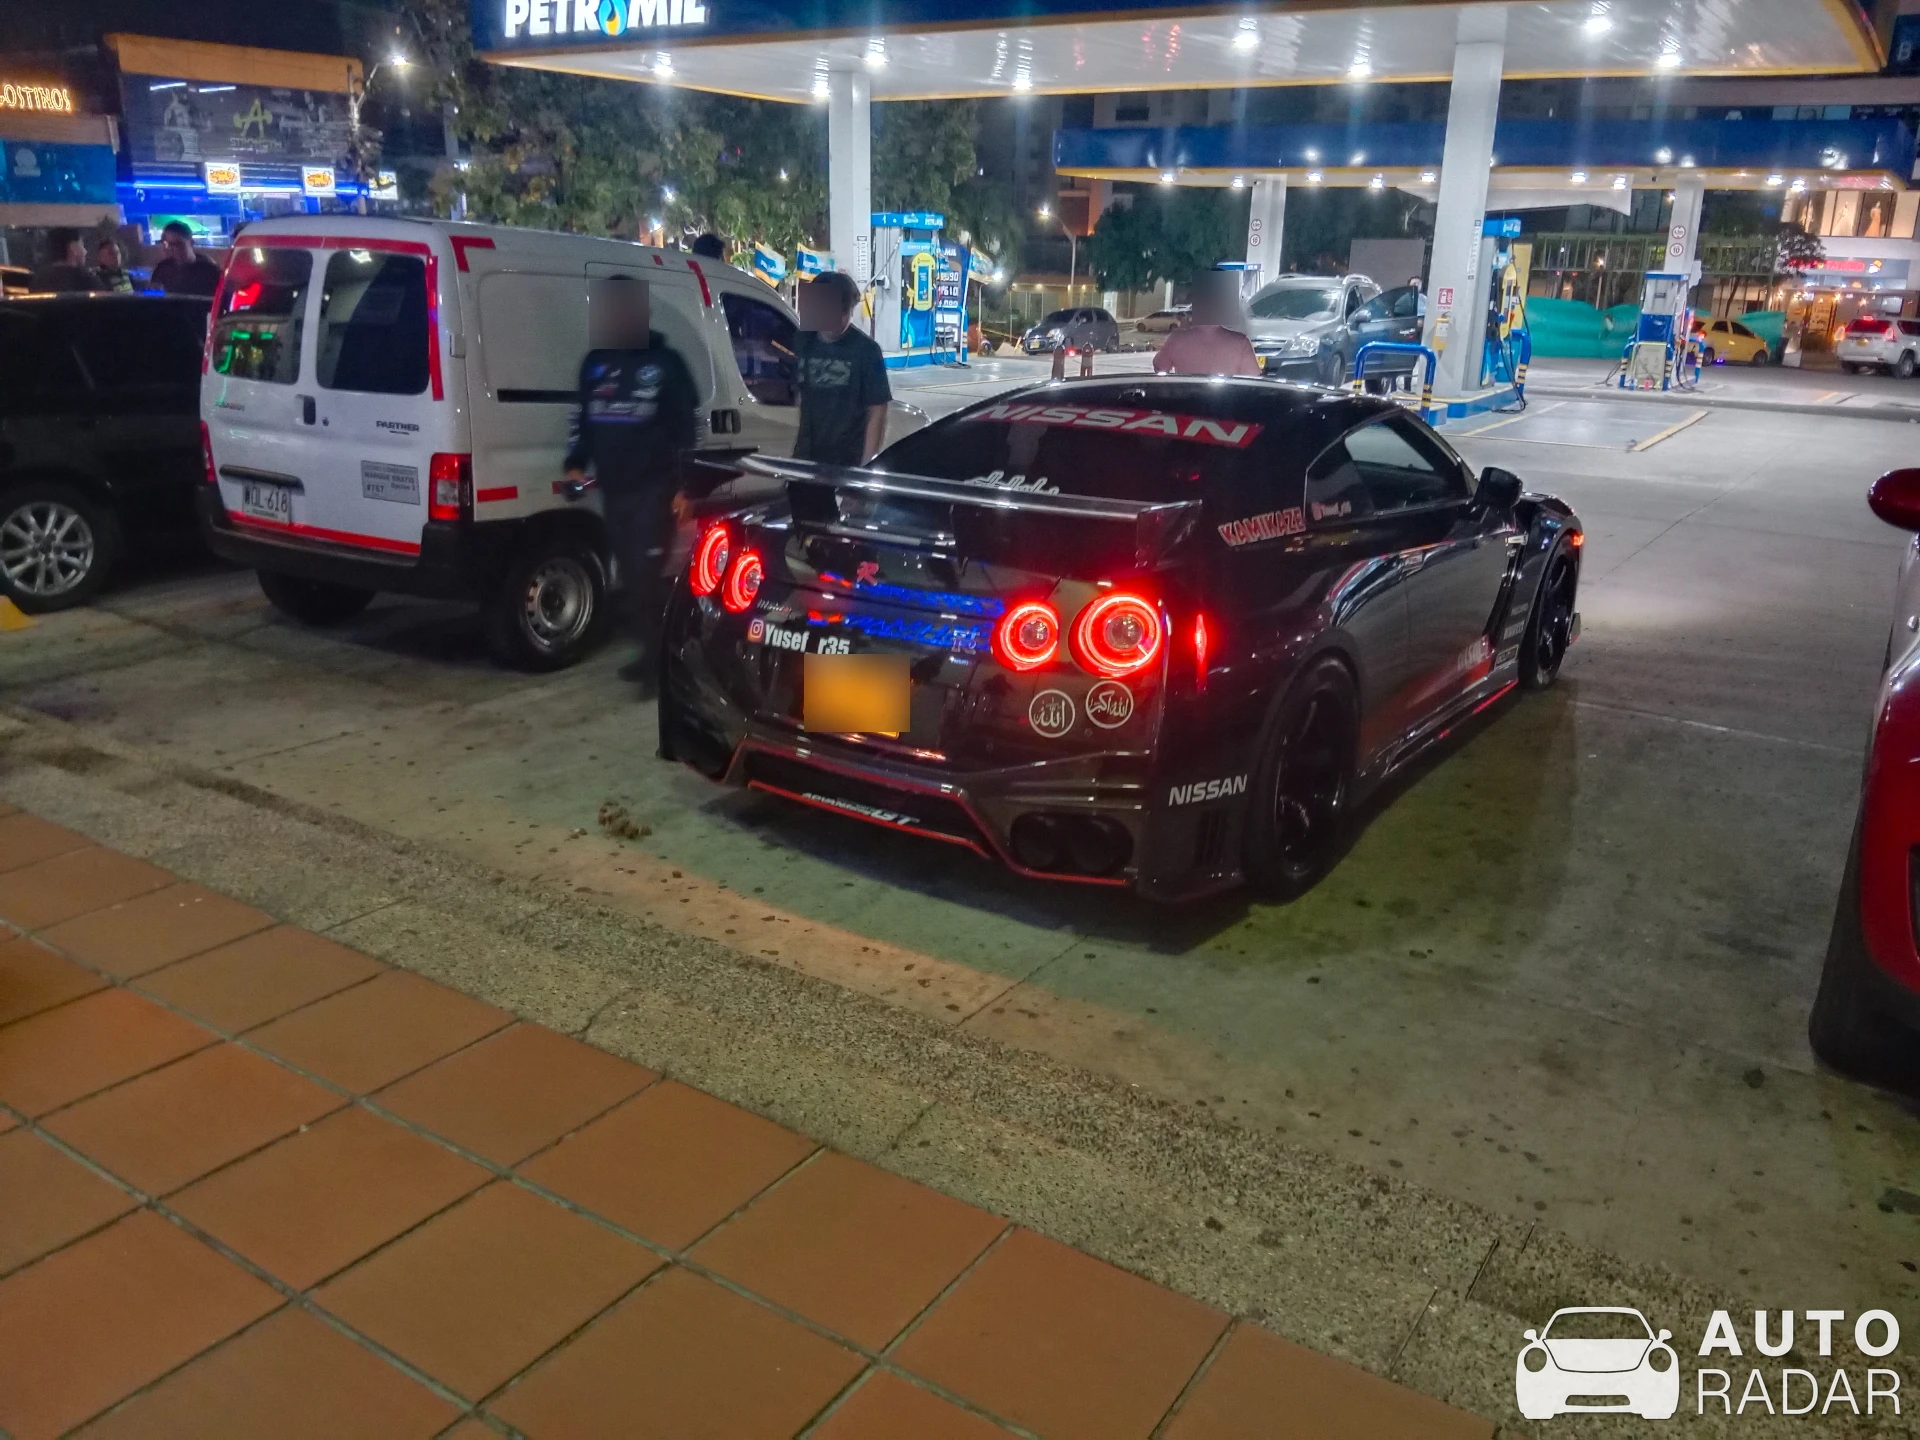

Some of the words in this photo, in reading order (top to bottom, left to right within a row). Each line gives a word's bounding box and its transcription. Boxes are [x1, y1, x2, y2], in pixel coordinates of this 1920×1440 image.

[504, 0, 707, 38] PETROMIL
[376, 420, 420, 432] PARTNER
[959, 405, 1251, 444] NISSAN
[1217, 506, 1307, 547] KAMIKAZE
[1168, 773, 1248, 807] NISSAN
